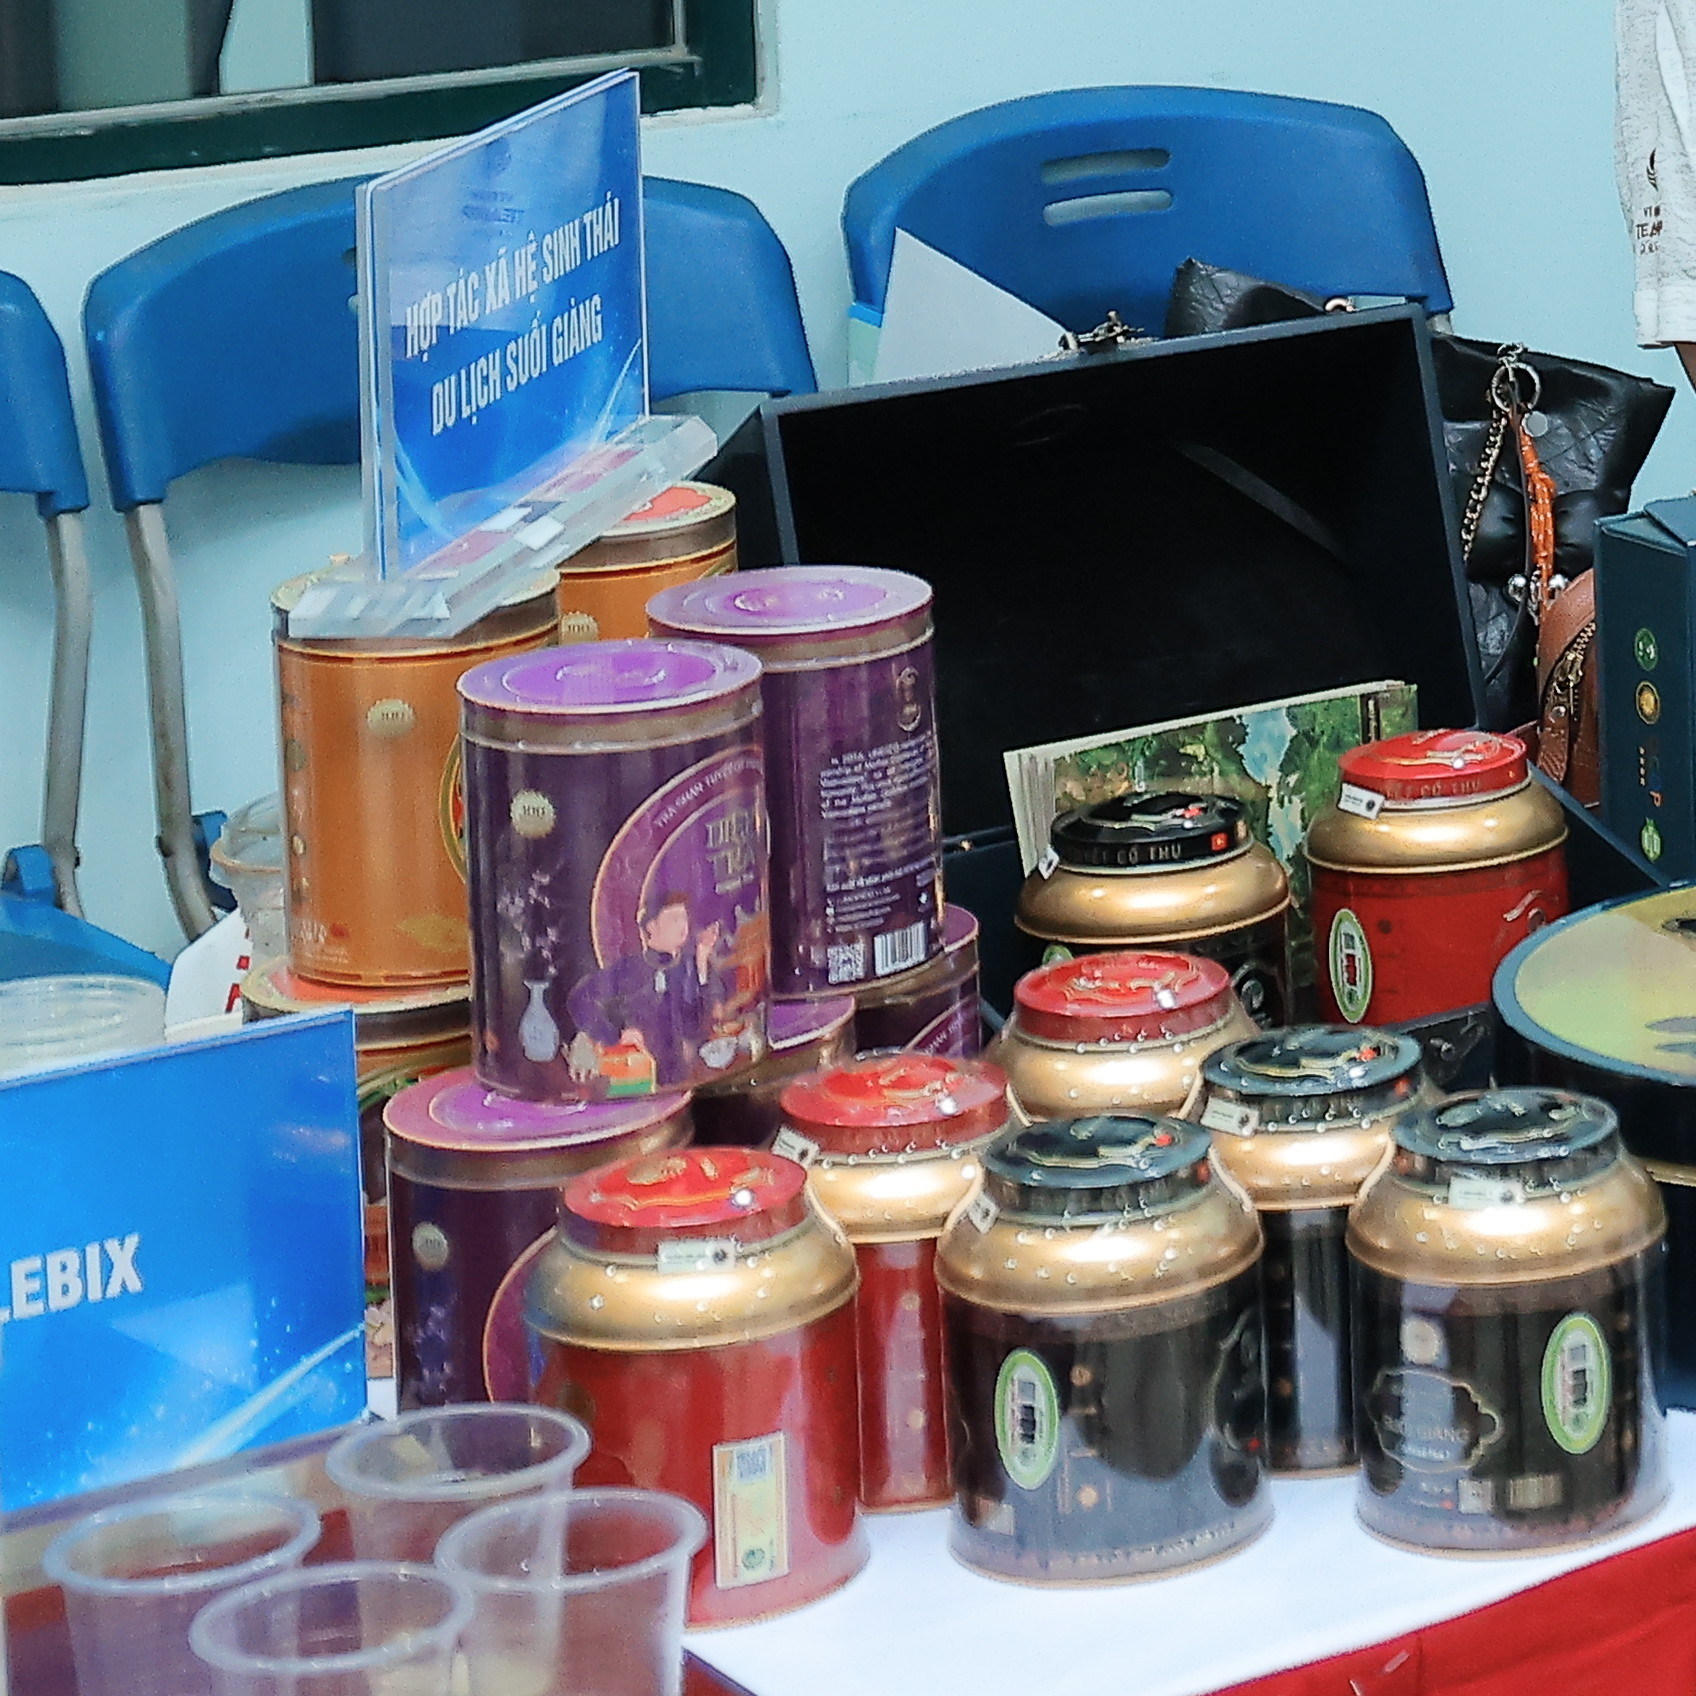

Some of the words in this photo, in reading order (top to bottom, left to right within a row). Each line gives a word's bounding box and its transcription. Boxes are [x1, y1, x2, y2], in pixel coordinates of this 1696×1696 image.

[406, 290, 443, 362] HỢP
[447, 268, 480, 334] TÁC
[484, 247, 510, 314] XÃ
[514, 230, 538, 303] HỆ
[542, 220, 582, 284] SINH
[583, 191, 620, 261] THÁI
[431, 373, 457, 436] DU
[460, 348, 501, 425] LỊCH
[506, 311, 548, 392] SUỐI
[552, 294, 603, 366] GIÀNG
